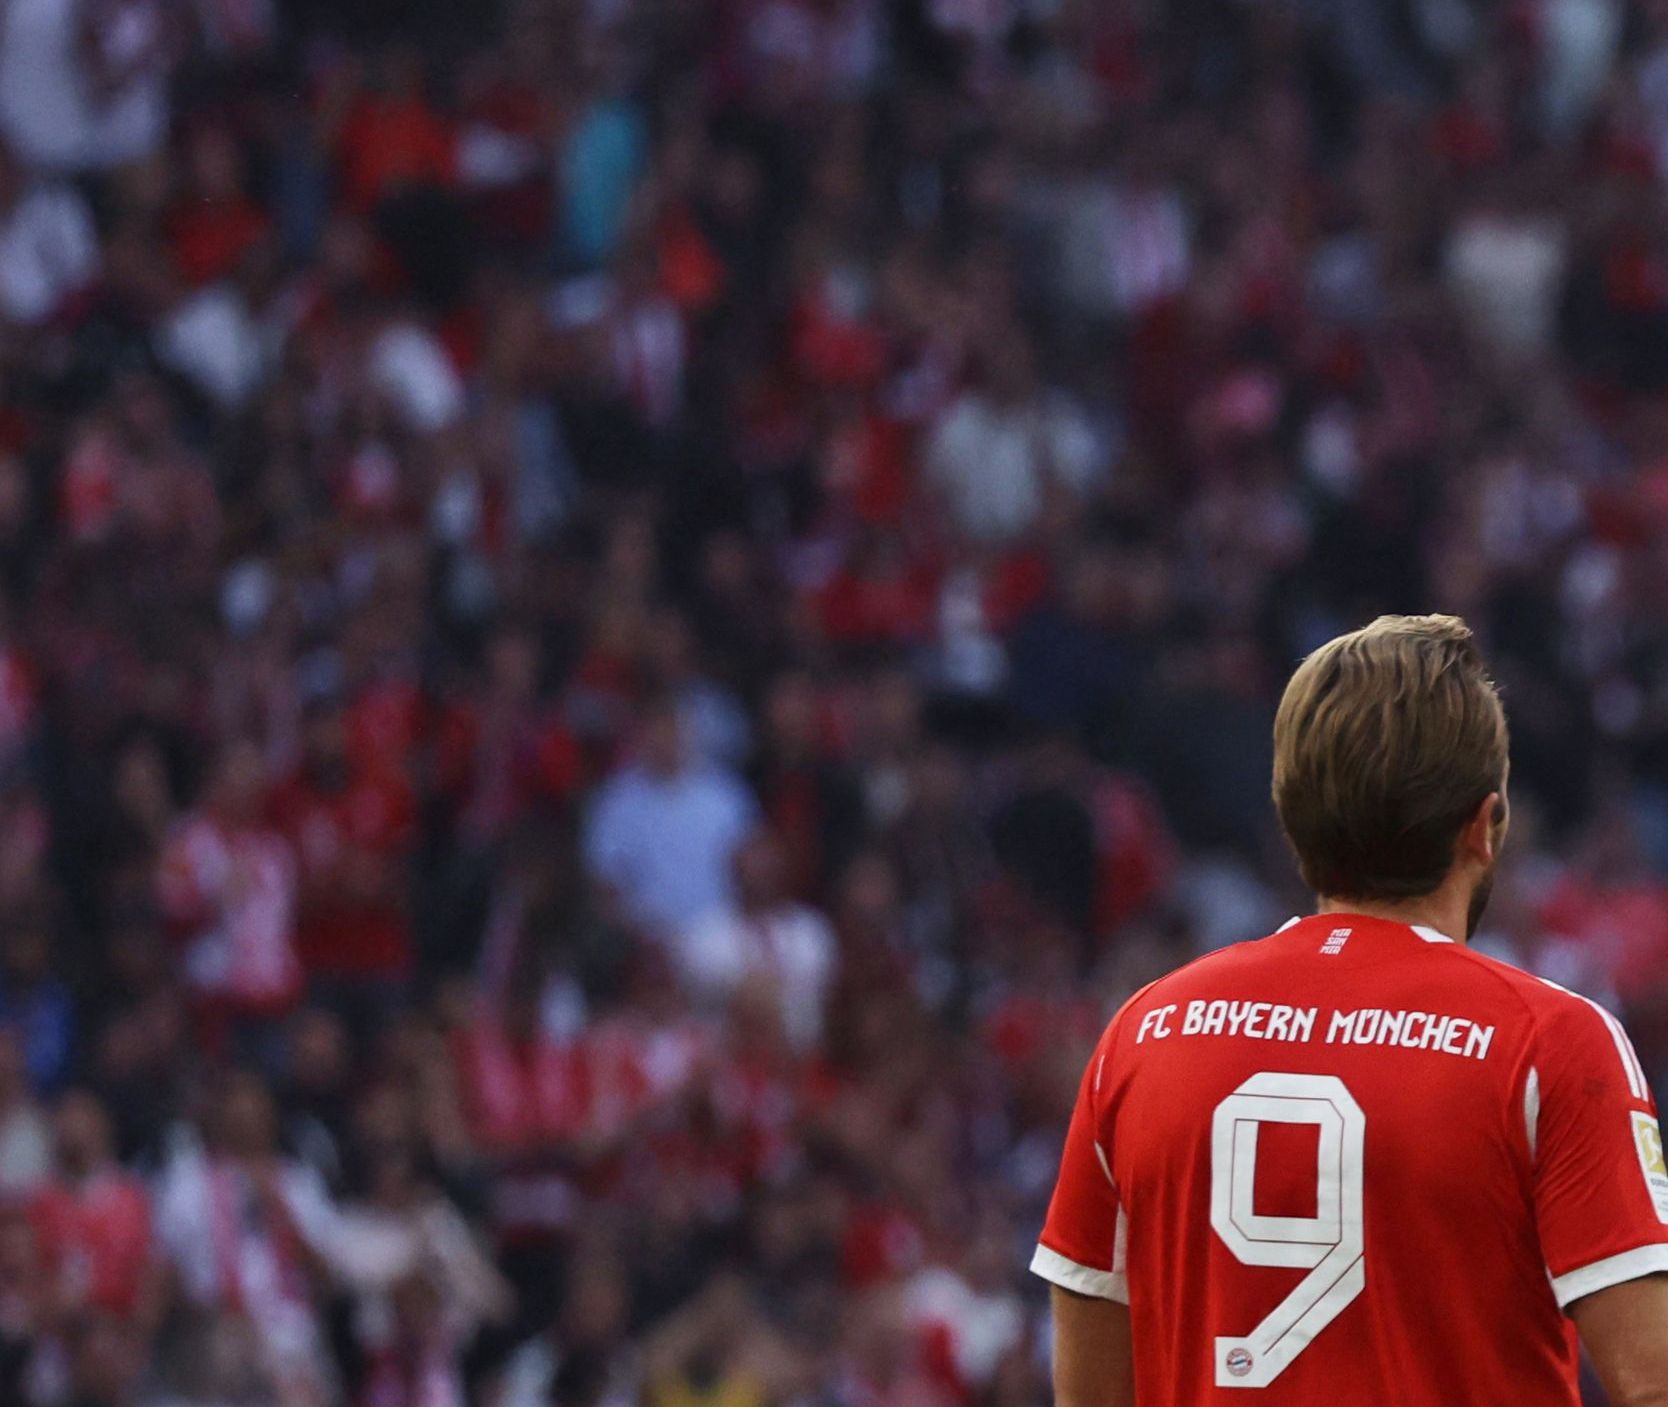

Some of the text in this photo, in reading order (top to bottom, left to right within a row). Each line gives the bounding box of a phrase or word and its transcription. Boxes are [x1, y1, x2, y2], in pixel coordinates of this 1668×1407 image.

[1136, 1000, 1496, 1060] FC BAYERN MÜNCHEN
[1211, 1071, 1366, 1389] 9
